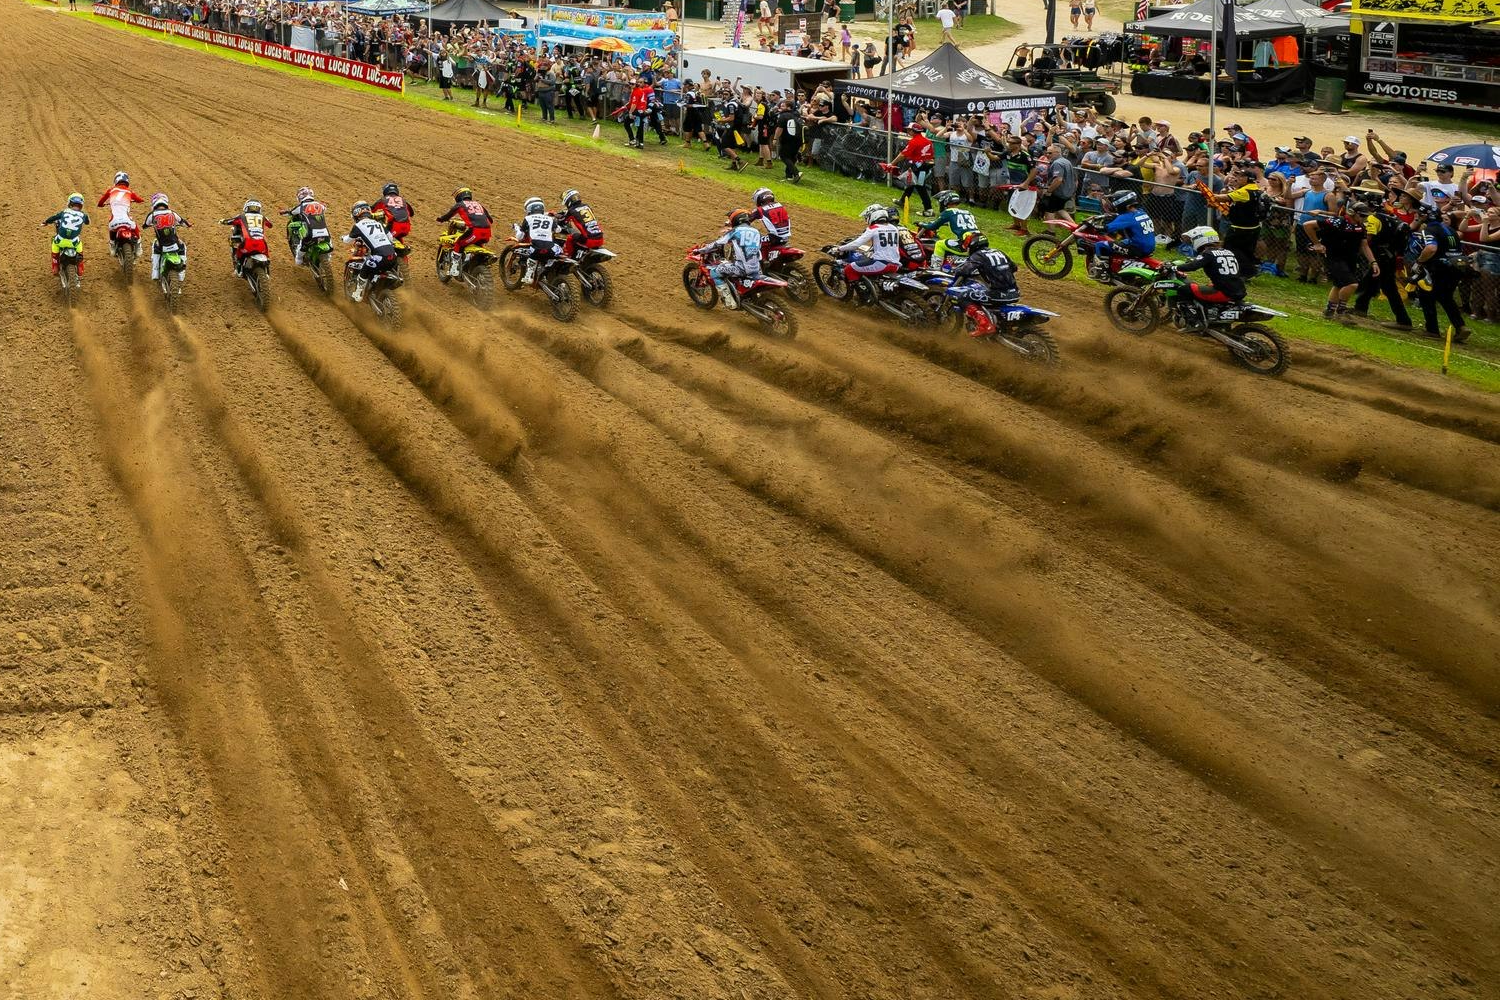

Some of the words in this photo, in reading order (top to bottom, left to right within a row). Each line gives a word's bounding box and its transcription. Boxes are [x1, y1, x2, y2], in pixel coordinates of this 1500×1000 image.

[1171, 11, 1214, 23] RIDE
[213, 33, 228, 45] LUCAS
[228, 36, 237, 47] OIL
[238, 39, 253, 51] LUCAS
[264, 44, 282, 58] LUCAS
[282, 49, 292, 61] OIL
[294, 52, 313, 66] LUCAS
[315, 55, 325, 69] OIL
[328, 59, 350, 75] LUCAS
[352, 64, 363, 78] OIL
[846, 85, 878, 98] SUPPORT
[880, 89, 906, 105] LOAL
[908, 95, 940, 110] MOTO
[1376, 83, 1458, 100] MOTOTEES
[61, 214, 84, 231] 32
[367, 224, 383, 236] 74
[532, 219, 551, 230] 38
[740, 230, 761, 247] 194
[1220, 310, 1240, 320] 351
